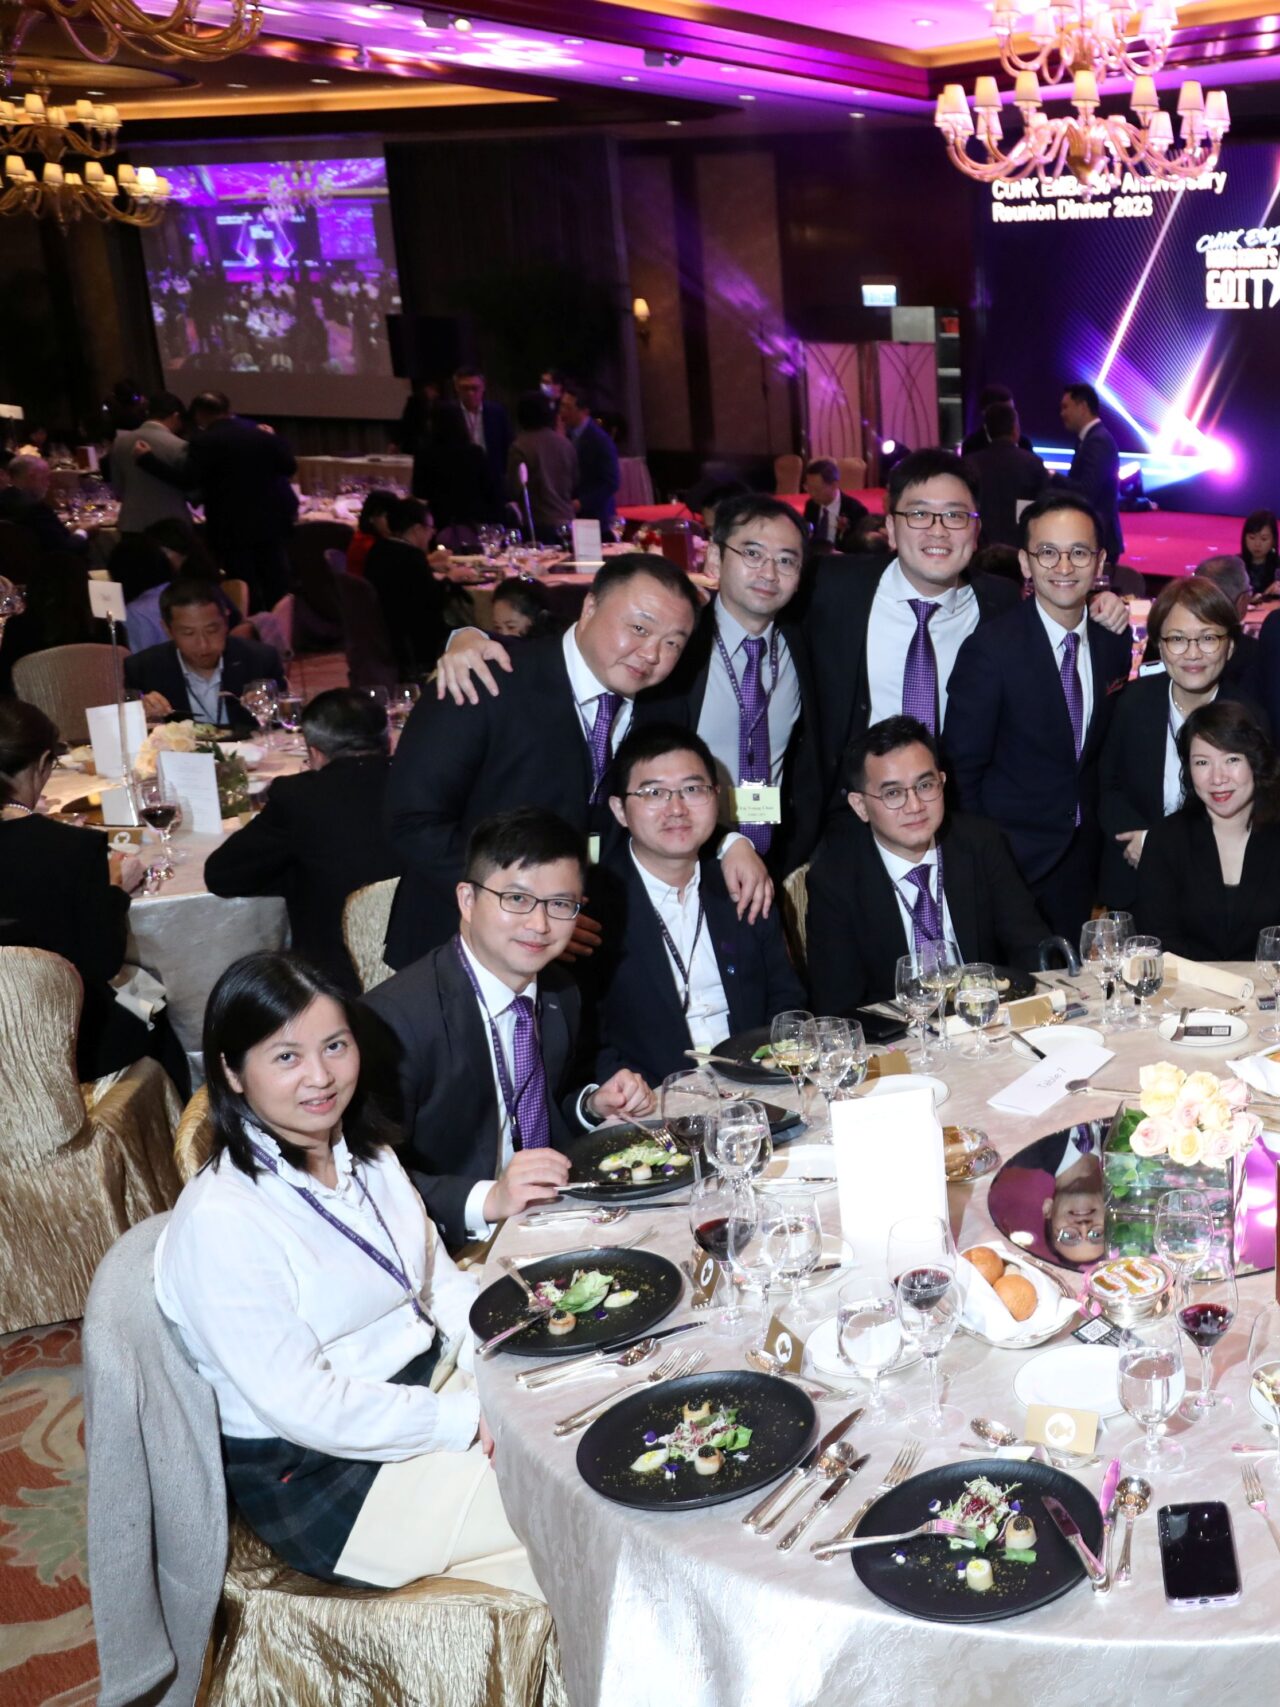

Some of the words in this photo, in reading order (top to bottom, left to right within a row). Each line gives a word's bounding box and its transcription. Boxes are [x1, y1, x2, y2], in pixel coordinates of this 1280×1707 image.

[992, 177, 1039, 199] CUHK
[992, 200, 1055, 222] Reunion
[1056, 199, 1111, 220] Dinner
[1113, 195, 1153, 217] 2023
[1206, 269, 1249, 303] GOT
